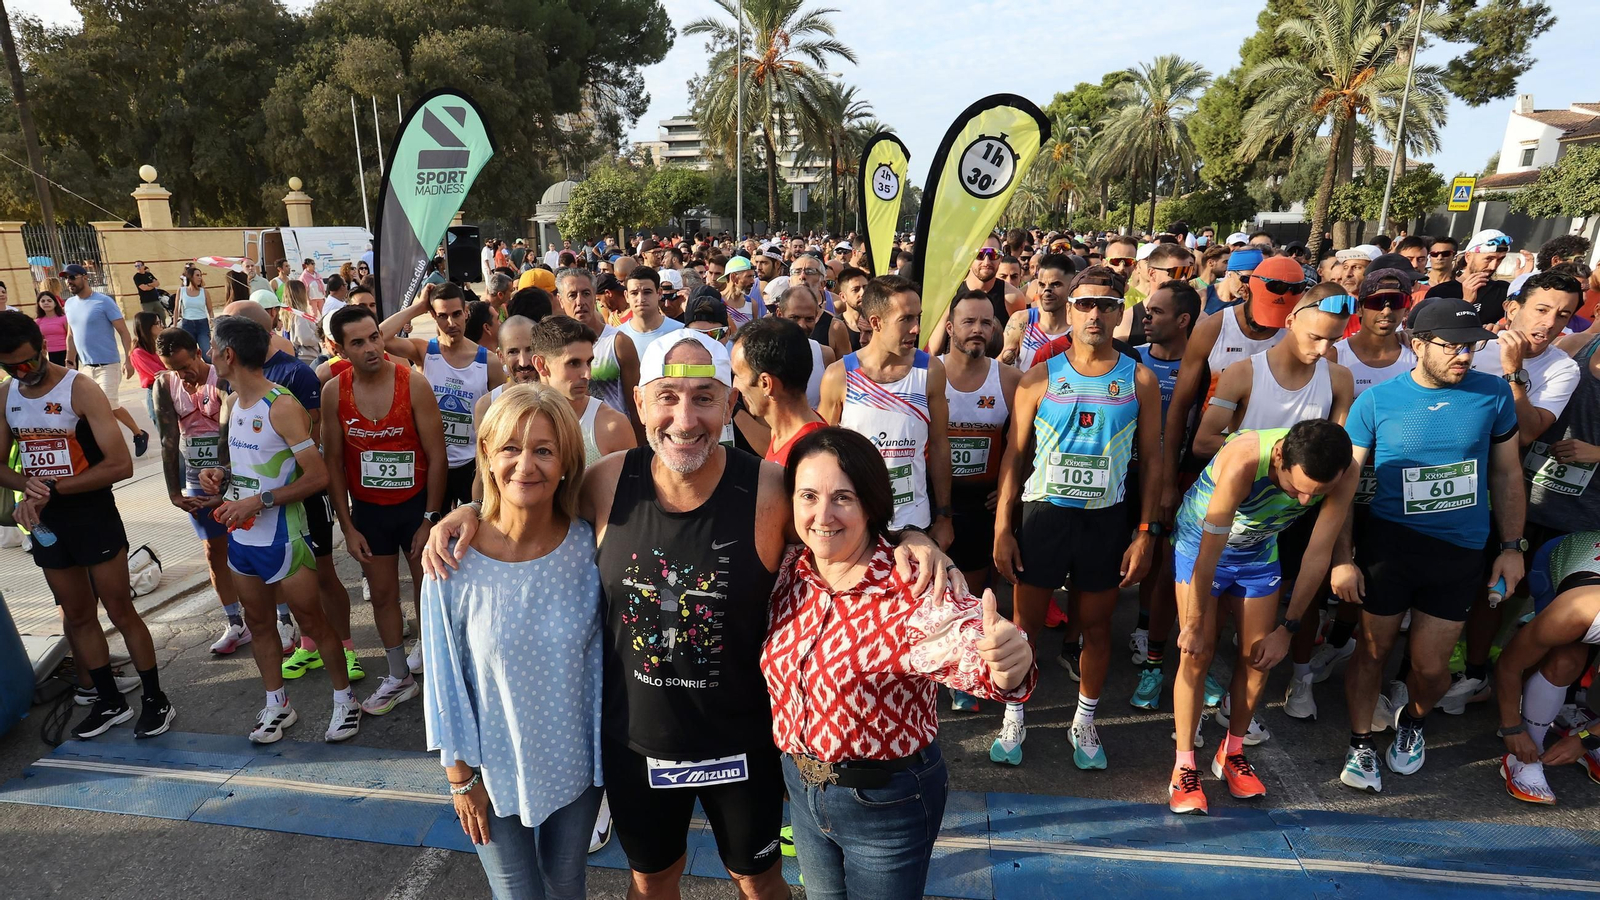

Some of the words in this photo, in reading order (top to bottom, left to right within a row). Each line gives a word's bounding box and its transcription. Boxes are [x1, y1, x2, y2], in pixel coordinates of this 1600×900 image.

[982, 142, 1005, 168] 1h
[416, 171, 467, 185] SPORT
[880, 169, 891, 181] 1h
[415, 184, 465, 196] MADNESS
[434, 385, 474, 399] RUNNERS
[948, 421, 998, 429] RUBYSAN
[347, 427, 404, 438] ESPAÑA
[29, 452, 56, 466] 260
[197, 447, 213, 457] 64
[379, 464, 397, 476] 93
[1062, 469, 1094, 485] 103
[1543, 462, 1567, 478] 48
[1430, 480, 1454, 497] 60
[716, 556, 730, 600] NIKE
[709, 611, 725, 687] RUNNING
[633, 669, 662, 687] PABLO
[665, 677, 707, 688] SONRIE
